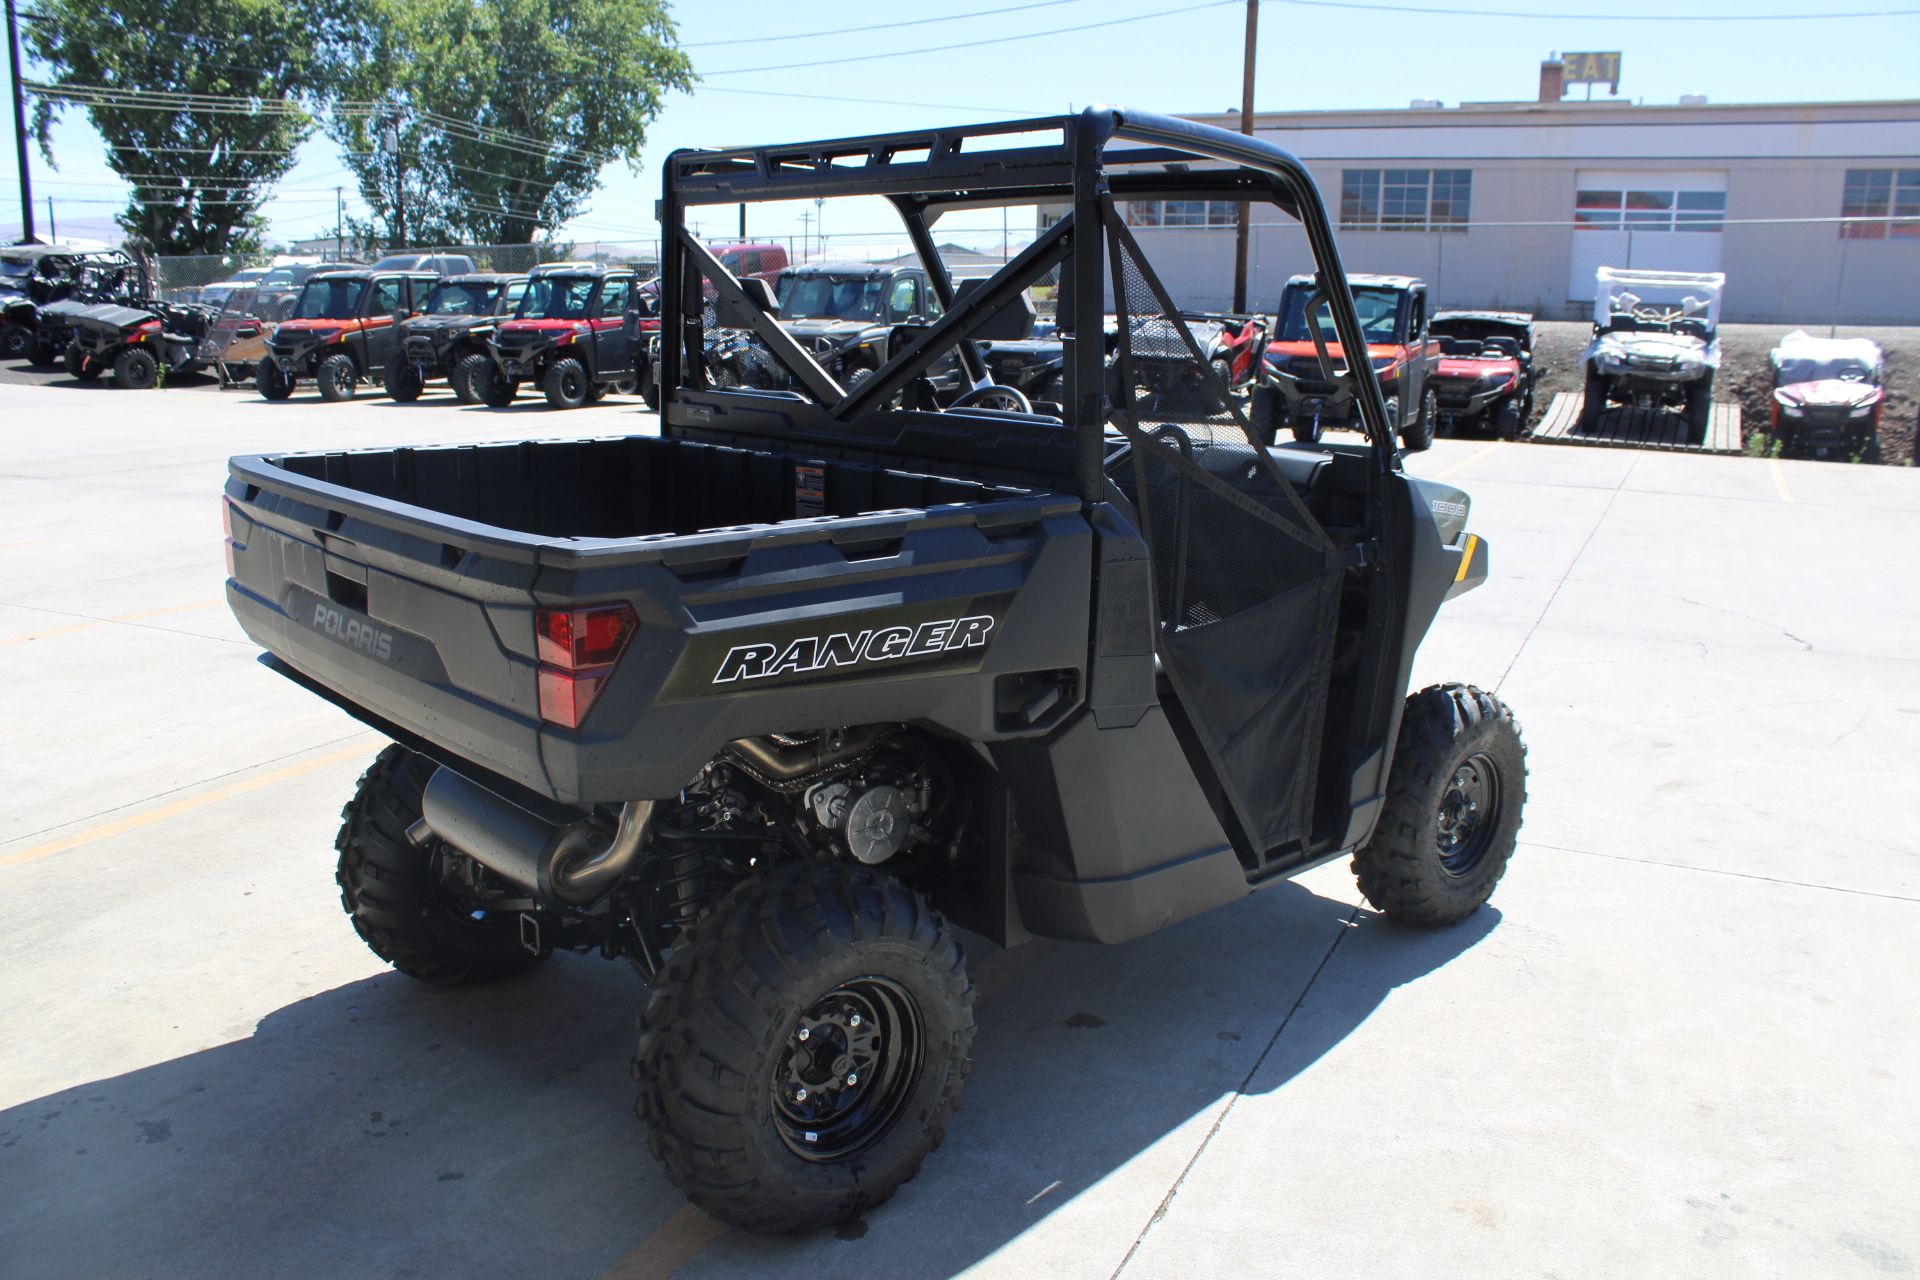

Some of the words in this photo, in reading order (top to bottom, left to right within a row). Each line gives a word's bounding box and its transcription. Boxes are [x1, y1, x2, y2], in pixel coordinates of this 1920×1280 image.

[1564, 54, 1619, 79] EAT
[313, 603, 393, 660] POLARIS
[712, 615, 995, 684] RANGER
